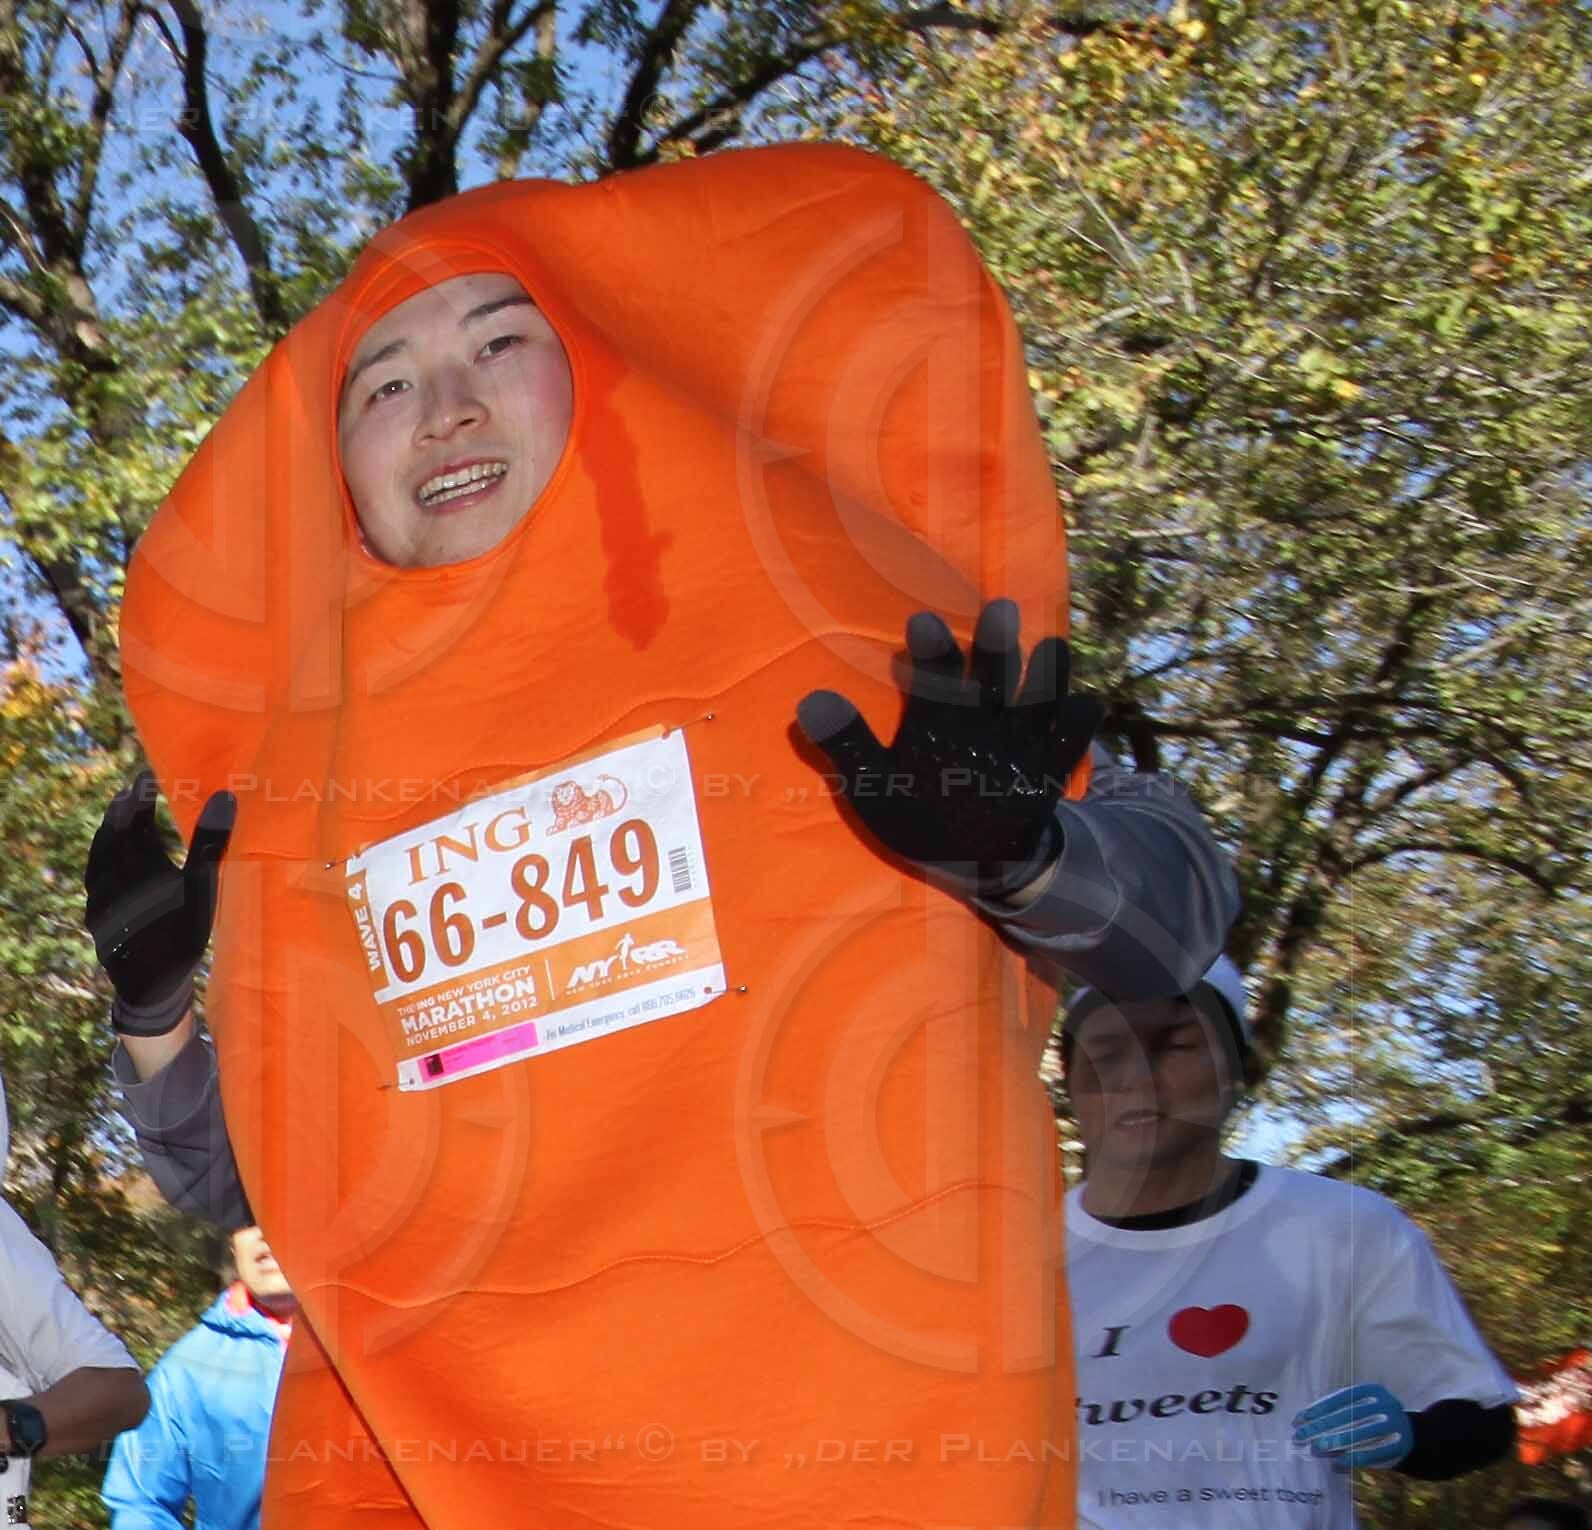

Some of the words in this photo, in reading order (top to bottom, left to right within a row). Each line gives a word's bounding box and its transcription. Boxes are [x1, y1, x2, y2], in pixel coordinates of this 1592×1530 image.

[406, 808, 533, 885] ING
[347, 882, 363, 899] 4
[383, 818, 660, 983] 66-849
[354, 907, 382, 971] WAVE
[401, 976, 535, 1035] MARATHON
[437, 986, 465, 1003] NEW
[468, 975, 500, 992] YORK
[503, 965, 530, 981] CITY
[406, 1015, 476, 1047] NOVEMBER
[502, 996, 537, 1016] 2012
[1091, 1325, 1131, 1358] I
[1074, 1383, 1279, 1426] weets
[1109, 1487, 1168, 1506] have
[1176, 1488, 1192, 1502] a
[1200, 1486, 1268, 1502] sweet
